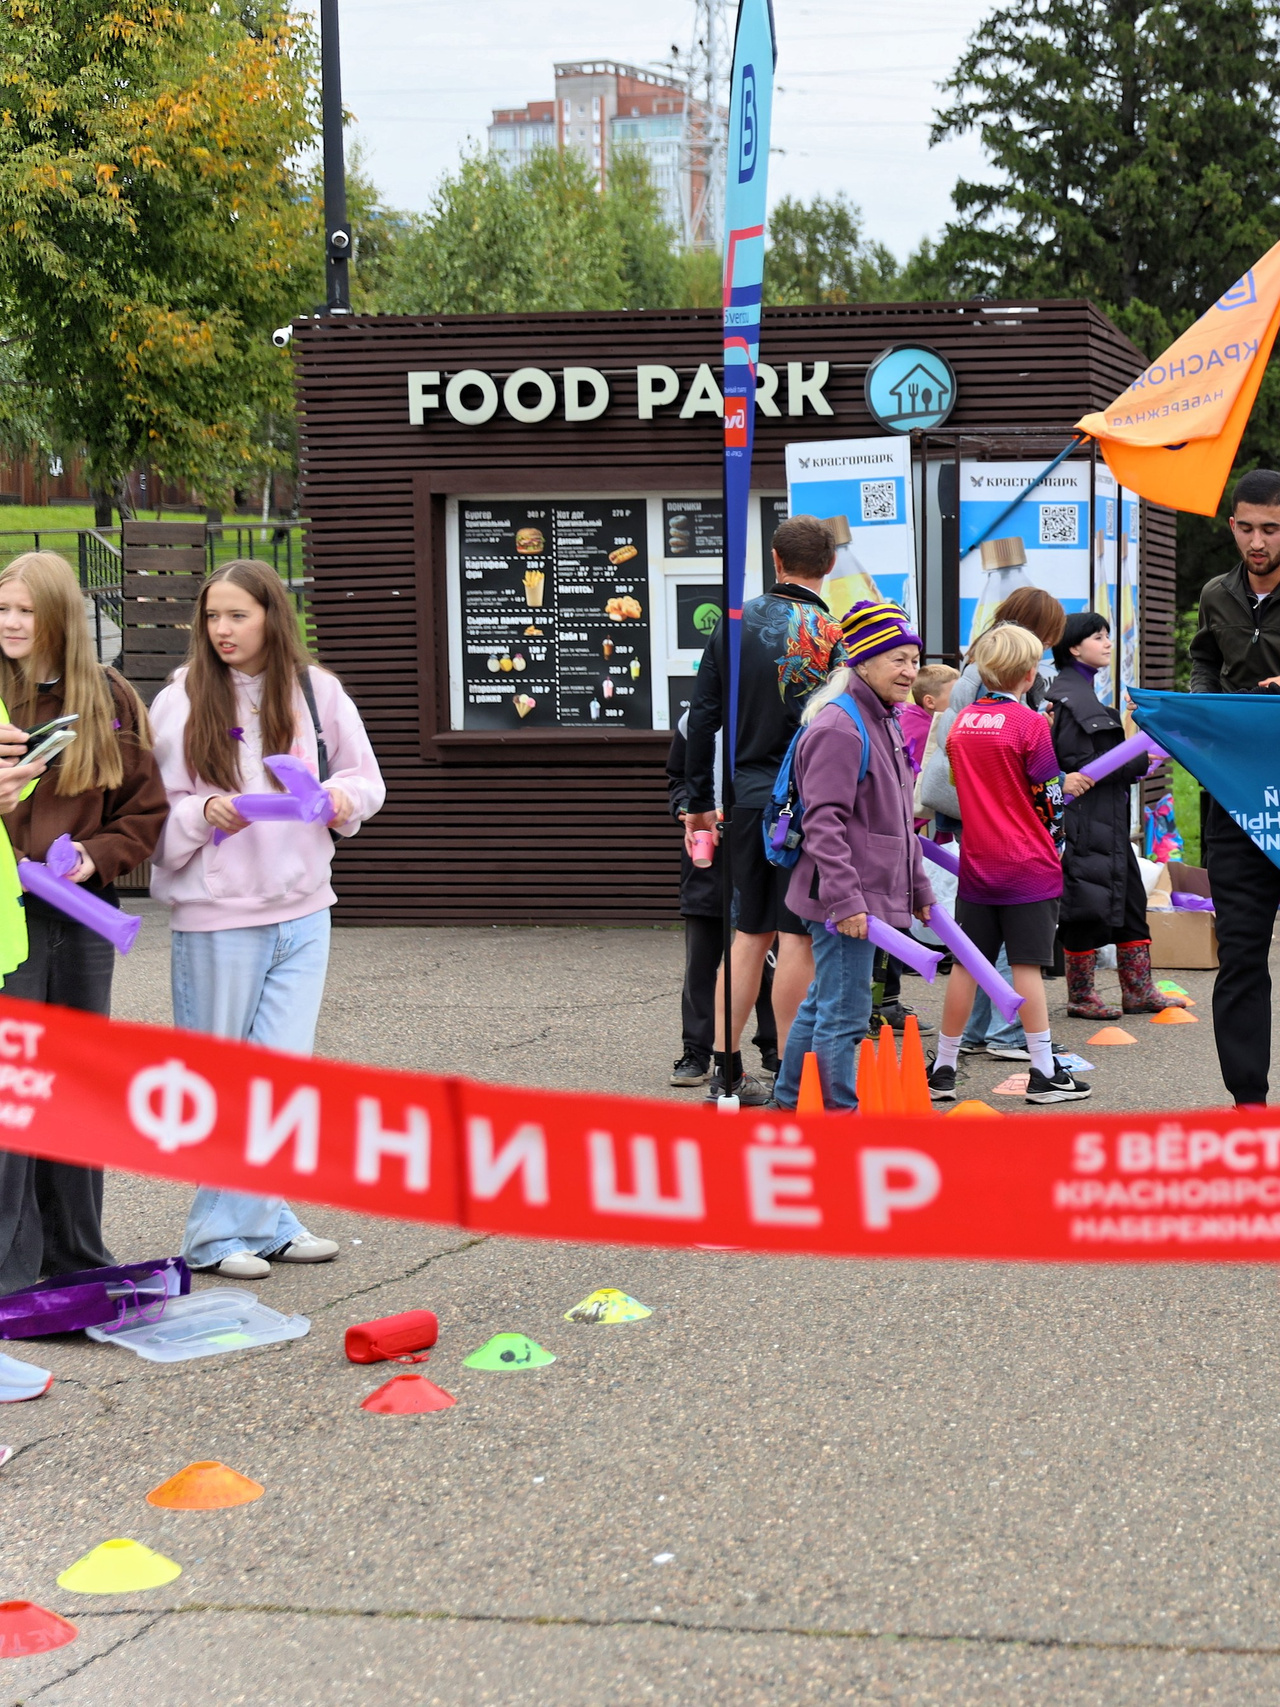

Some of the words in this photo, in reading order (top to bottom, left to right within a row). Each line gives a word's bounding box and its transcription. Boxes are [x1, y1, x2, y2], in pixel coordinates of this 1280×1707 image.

[408, 366, 610, 427] FOOD
[637, 361, 835, 420] PARK
[667, 502, 702, 511] ПОНЧИКИ
[465, 510, 492, 520] Бургер
[557, 510, 570, 520] Хот
[571, 511, 584, 520] дог
[465, 561, 509, 570] Картофель
[466, 616, 499, 625] Сырные
[500, 616, 533, 625] палочки
[467, 645, 510, 654] Макаруны
[469, 684, 516, 694] Мороженое
[126, 1059, 942, 1232] ФИНИШЁР
[1074, 1132, 1106, 1172] 5
